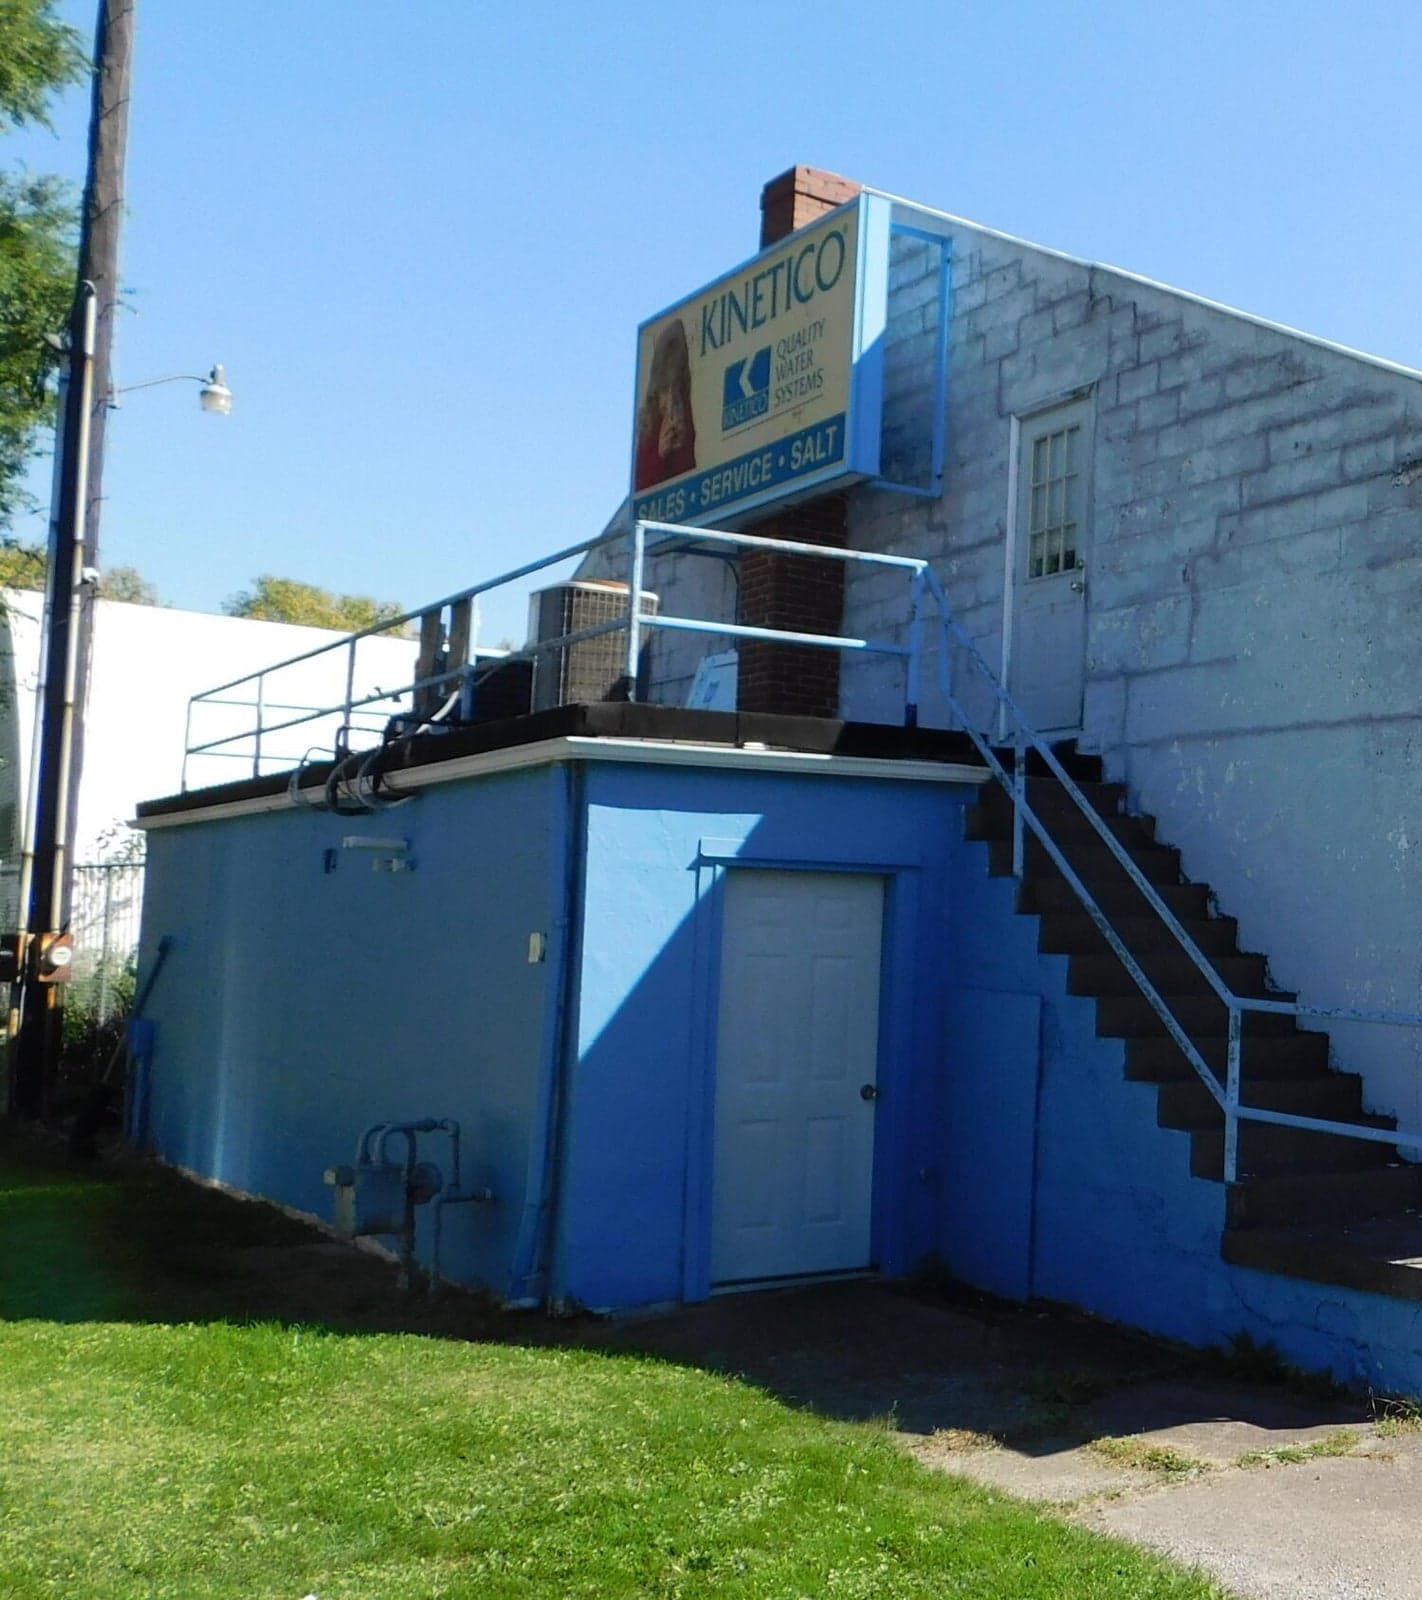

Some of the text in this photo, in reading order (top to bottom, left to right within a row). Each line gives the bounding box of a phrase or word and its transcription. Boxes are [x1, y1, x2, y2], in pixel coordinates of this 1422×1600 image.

[701, 229, 846, 357] KINETICO
[776, 317, 826, 361] QUALITY
[776, 348, 814, 382] WATER
[774, 367, 825, 408] SYSTEMS
[701, 452, 772, 506] SERVICE
[791, 425, 839, 471] SALT
